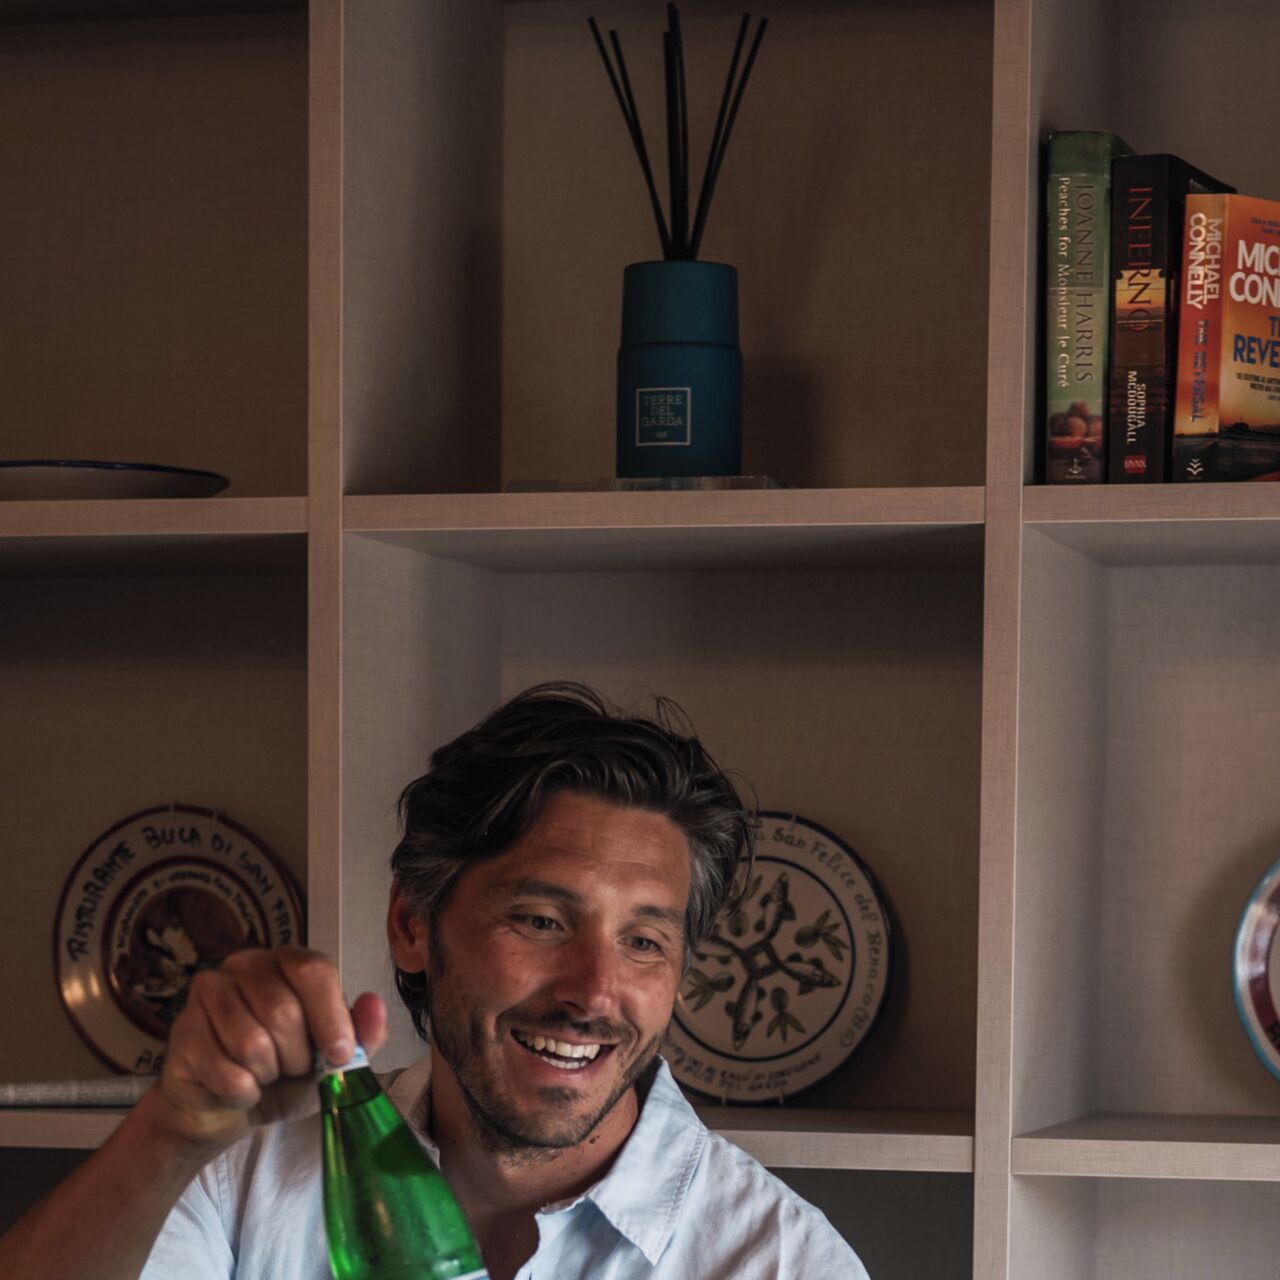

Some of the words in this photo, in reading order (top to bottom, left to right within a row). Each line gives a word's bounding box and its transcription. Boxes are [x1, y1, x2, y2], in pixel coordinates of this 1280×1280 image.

[1057, 177, 1072, 231] Peaches
[1074, 185, 1095, 281] JOANNE
[1057, 236, 1072, 257] for
[1127, 187, 1153, 333] INFERNO
[1186, 212, 1207, 311] CONNELLY
[1203, 218, 1222, 301] MICHAEL
[1056, 264, 1071, 329] Monsieur
[1057, 336, 1071, 347] le
[1075, 292, 1094, 382] HARRIS
[1196, 320, 1208, 346] THE
[642, 394, 684, 406] TERRE
[1056, 353, 1070, 388] Curé
[1191, 352, 1208, 423] REVERSAL
[641, 416, 685, 427] GARDA
[650, 405, 675, 416] DEL
[1126, 371, 1138, 445] MCDOUGALL
[1135, 383, 1147, 429] SOPHIA
[140, 826, 202, 850] BUCA
[211, 834, 232, 856] DI
[239, 852, 273, 895] SAN
[773, 827, 807, 849] San
[810, 841, 857, 888] Felice
